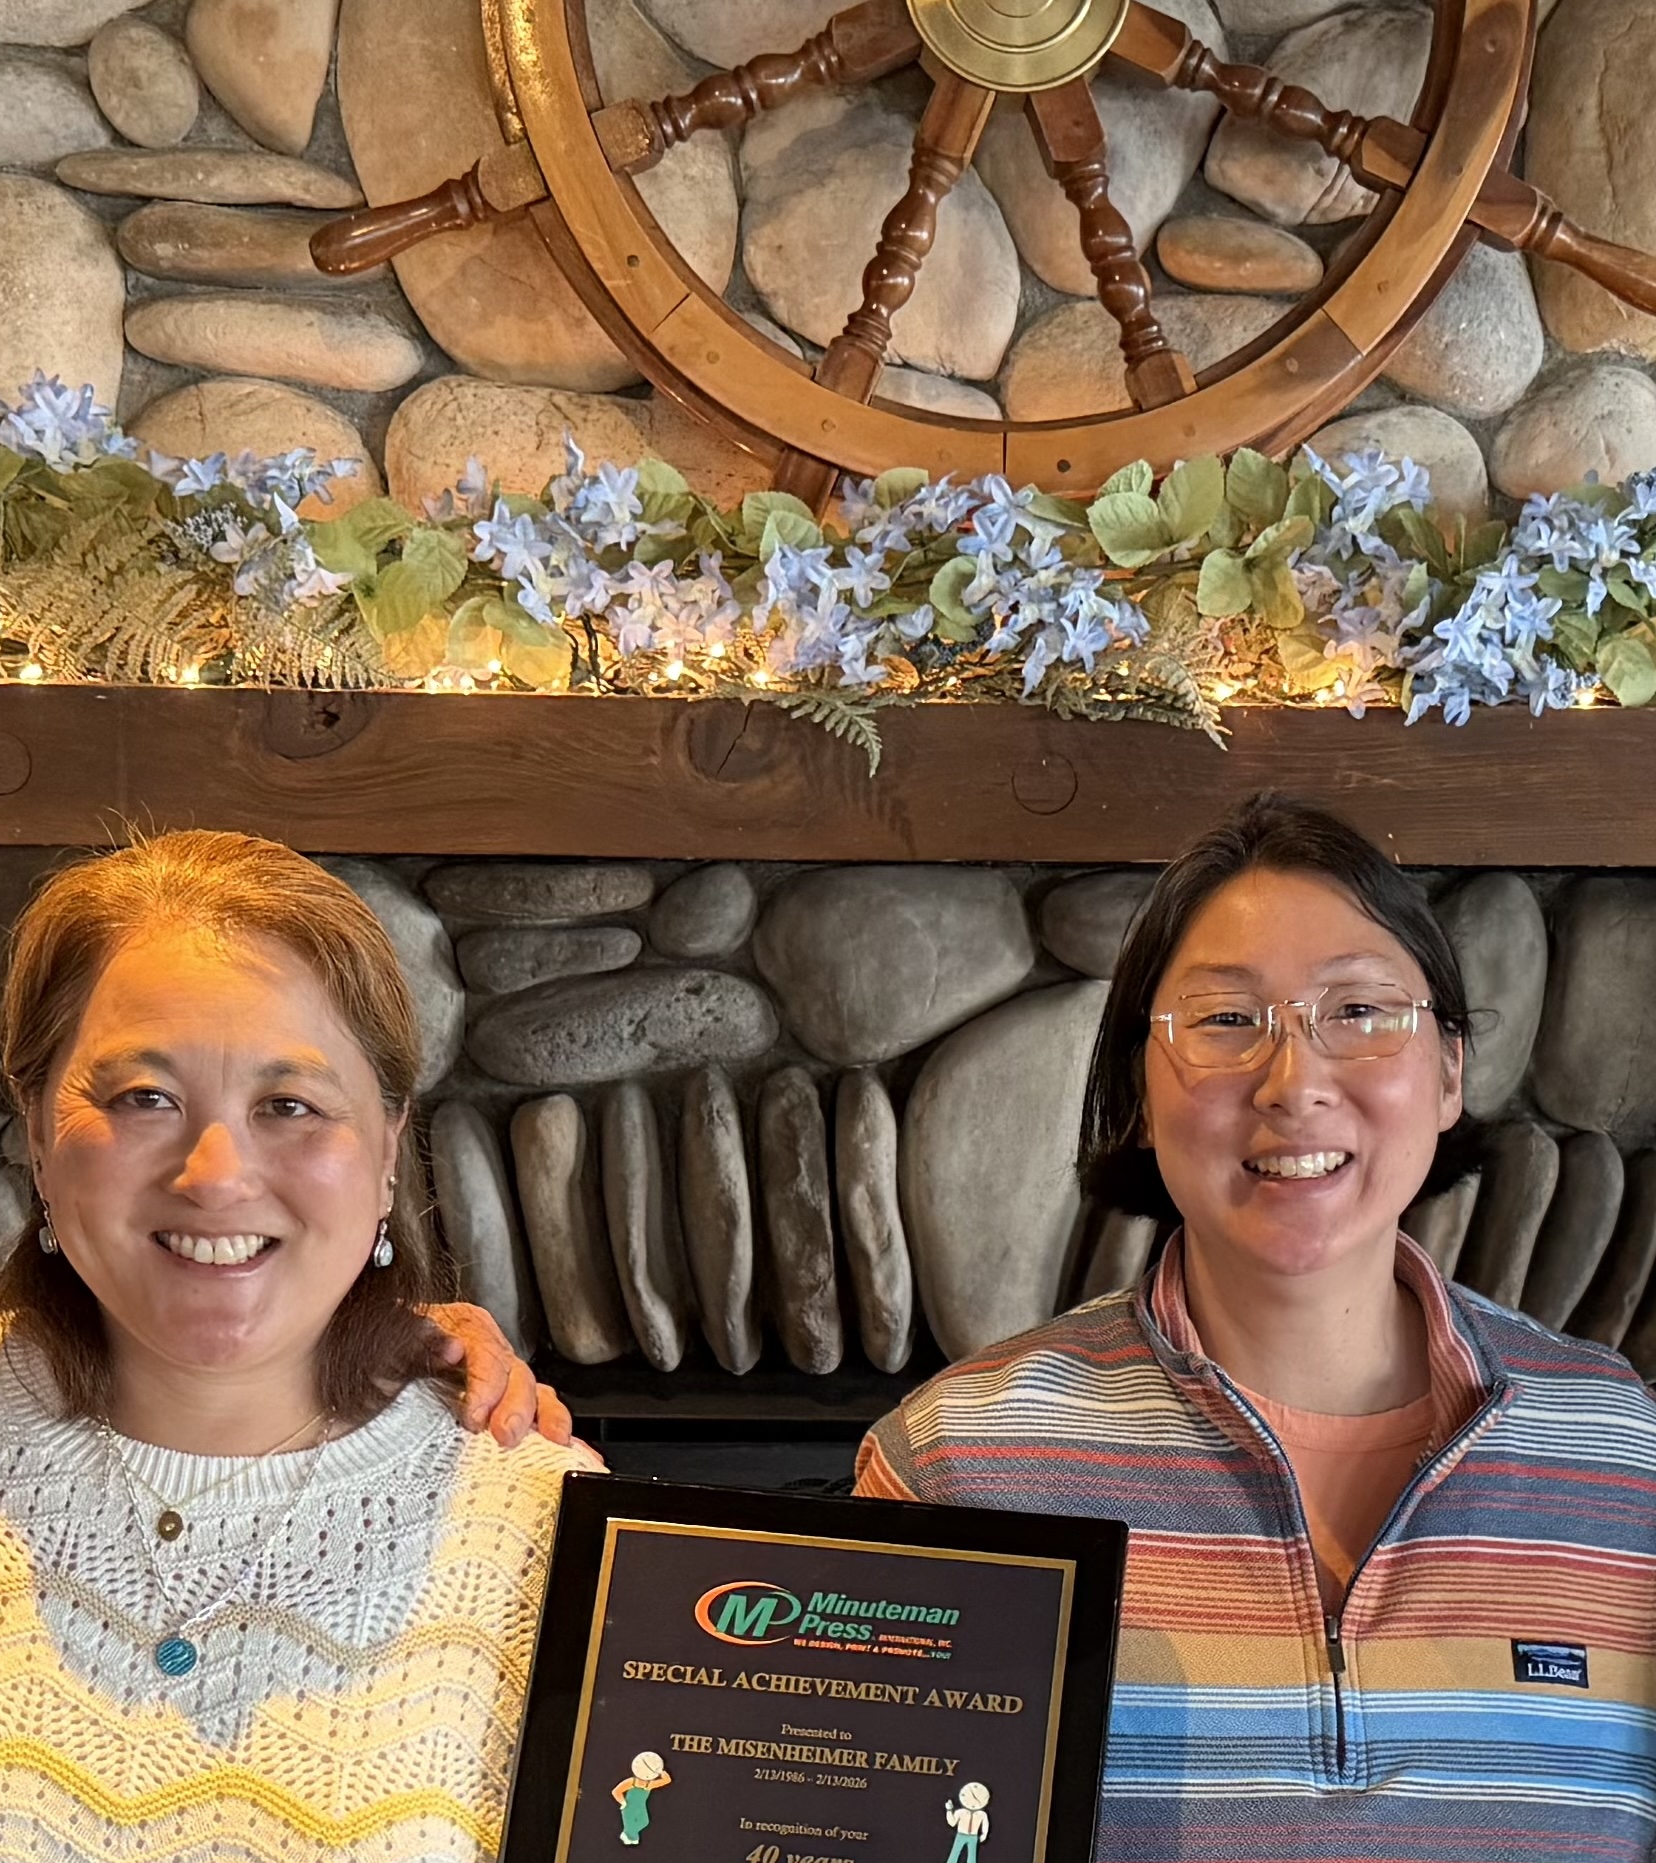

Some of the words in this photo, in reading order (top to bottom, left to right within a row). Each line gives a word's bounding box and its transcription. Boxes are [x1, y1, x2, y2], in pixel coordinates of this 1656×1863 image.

[808, 1592, 960, 1625] Minuteman
[798, 1614, 873, 1641] Press
[623, 1661, 727, 1686] SPECIAL
[732, 1672, 919, 1704] ACHIEVEMENT
[923, 1689, 1024, 1714] AWARD
[781, 1724, 837, 1739] Presented
[840, 1731, 852, 1740] to
[670, 1734, 712, 1753] THE
[717, 1737, 869, 1769] MISENHEIMER
[874, 1752, 960, 1776] FAMILY
[754, 1769, 805, 1783] 2/13/1986
[740, 1818, 752, 1829] In
[756, 1822, 822, 1836] recognition
[825, 1827, 839, 1837] of
[840, 1830, 869, 1840] your
